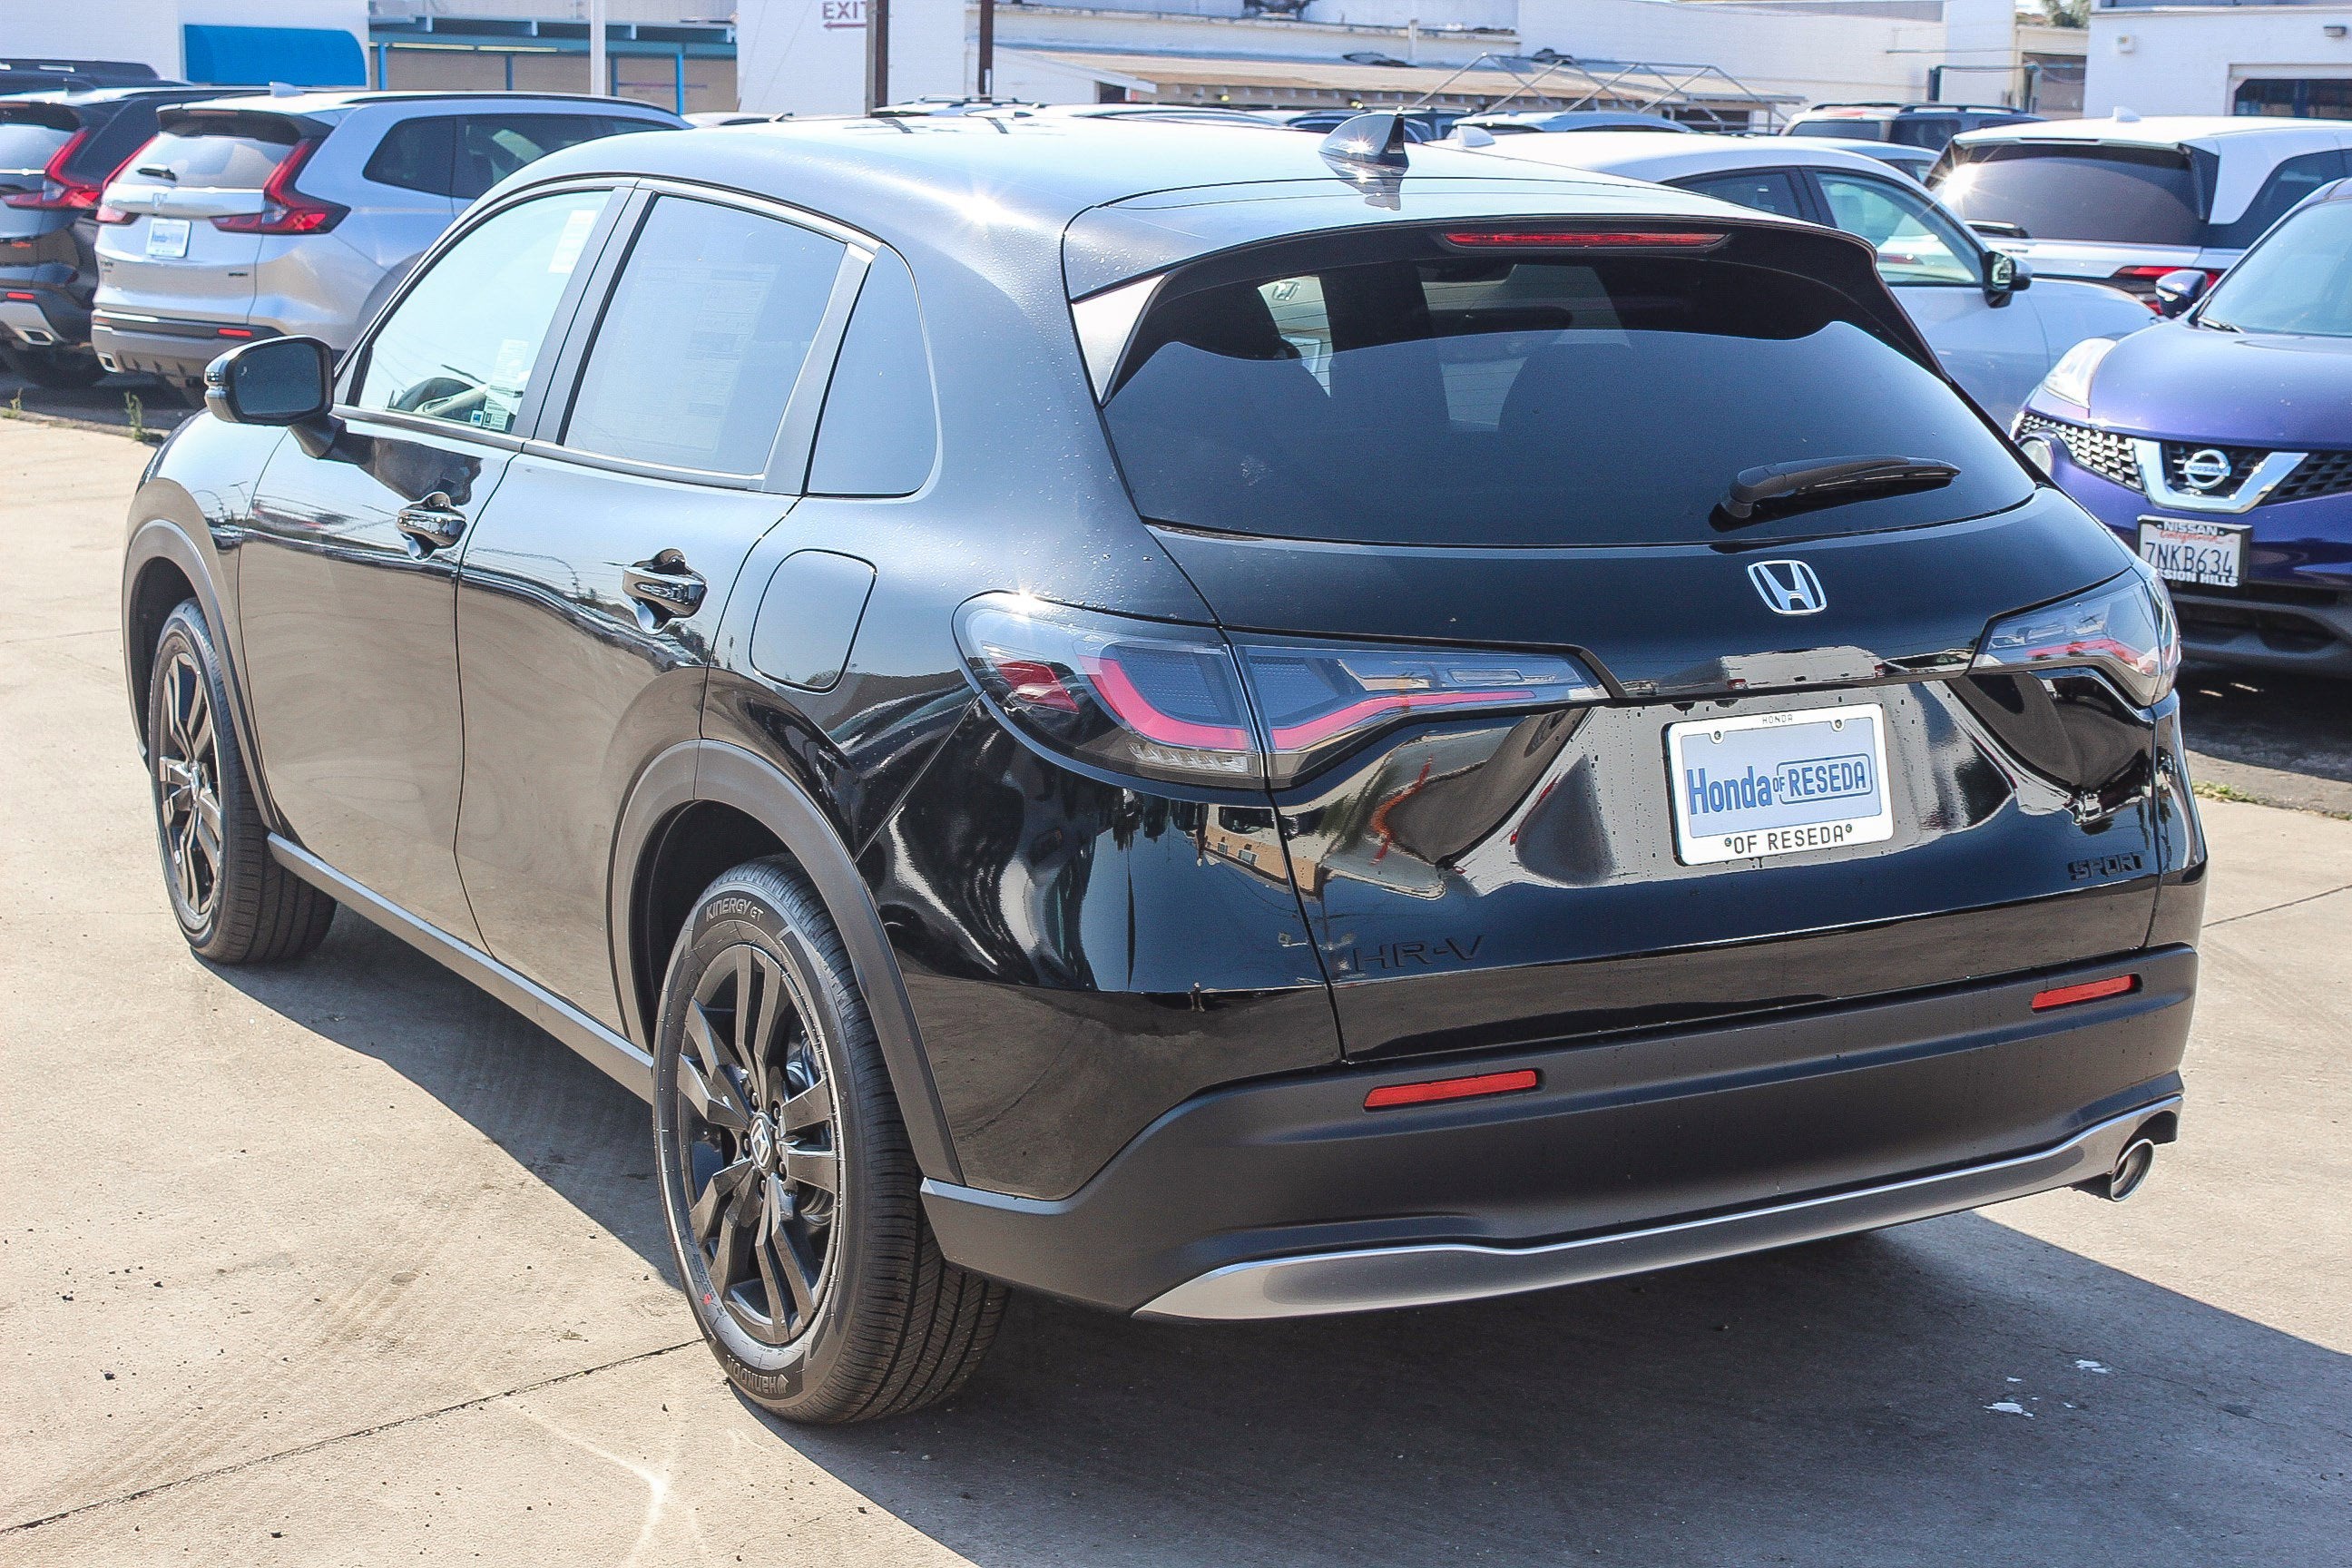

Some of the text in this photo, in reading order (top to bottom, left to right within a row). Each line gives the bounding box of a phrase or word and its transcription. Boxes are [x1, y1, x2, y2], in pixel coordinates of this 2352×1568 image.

[822, 1, 867, 19] EXI
[2163, 521, 2218, 535] NISSAN
[2145, 542, 2233, 575] 7NKB634
[2200, 573, 2239, 587] HILLS
[1762, 714, 1793, 724] HONDA
[1686, 761, 1867, 815] Honda OF RESEDA
[1733, 825, 1844, 854] OF RESEDA
[2068, 851, 2145, 880] SPORT
[706, 897, 765, 922] KINERGY GT
[1353, 934, 1485, 972] HR-V
